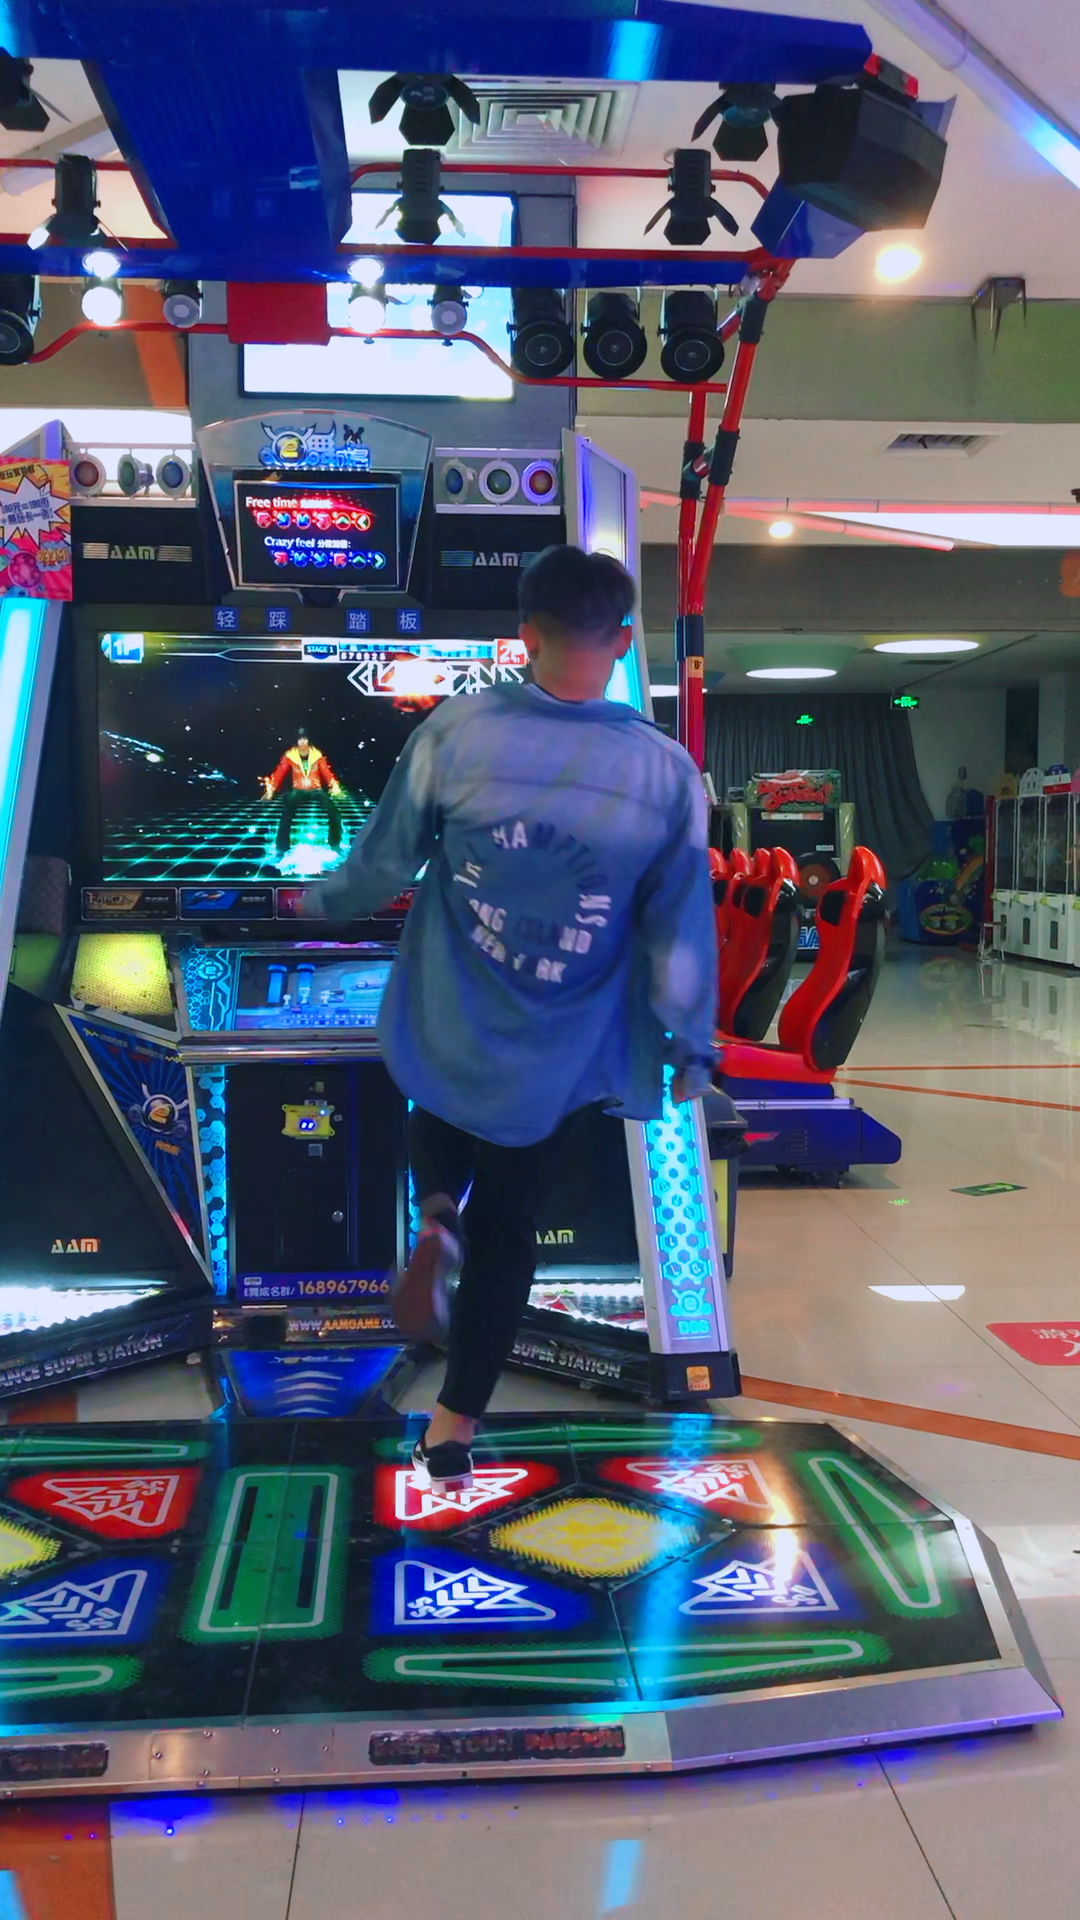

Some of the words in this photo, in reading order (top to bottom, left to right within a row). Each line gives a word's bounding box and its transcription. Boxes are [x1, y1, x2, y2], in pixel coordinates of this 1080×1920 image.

[245, 496, 271, 508] Free
[273, 497, 298, 508] time
[264, 536, 294, 549] Crazy
[295, 537, 315, 548] feel
[110, 545, 155, 560] AAM
[474, 552, 518, 567] AAM
[216, 609, 236, 628] 轻
[268, 611, 287, 629] 踩
[349, 613, 367, 630] 踏
[400, 613, 417, 630] 板
[306, 646, 328, 654] STAGE
[50, 1239, 98, 1253] AAM
[298, 1279, 390, 1296] 168967966
[44, 1352, 95, 1377] SUPER
[98, 1332, 163, 1363] STATION
[512, 1342, 556, 1364] SUPER
[558, 1350, 622, 1379] STATION
